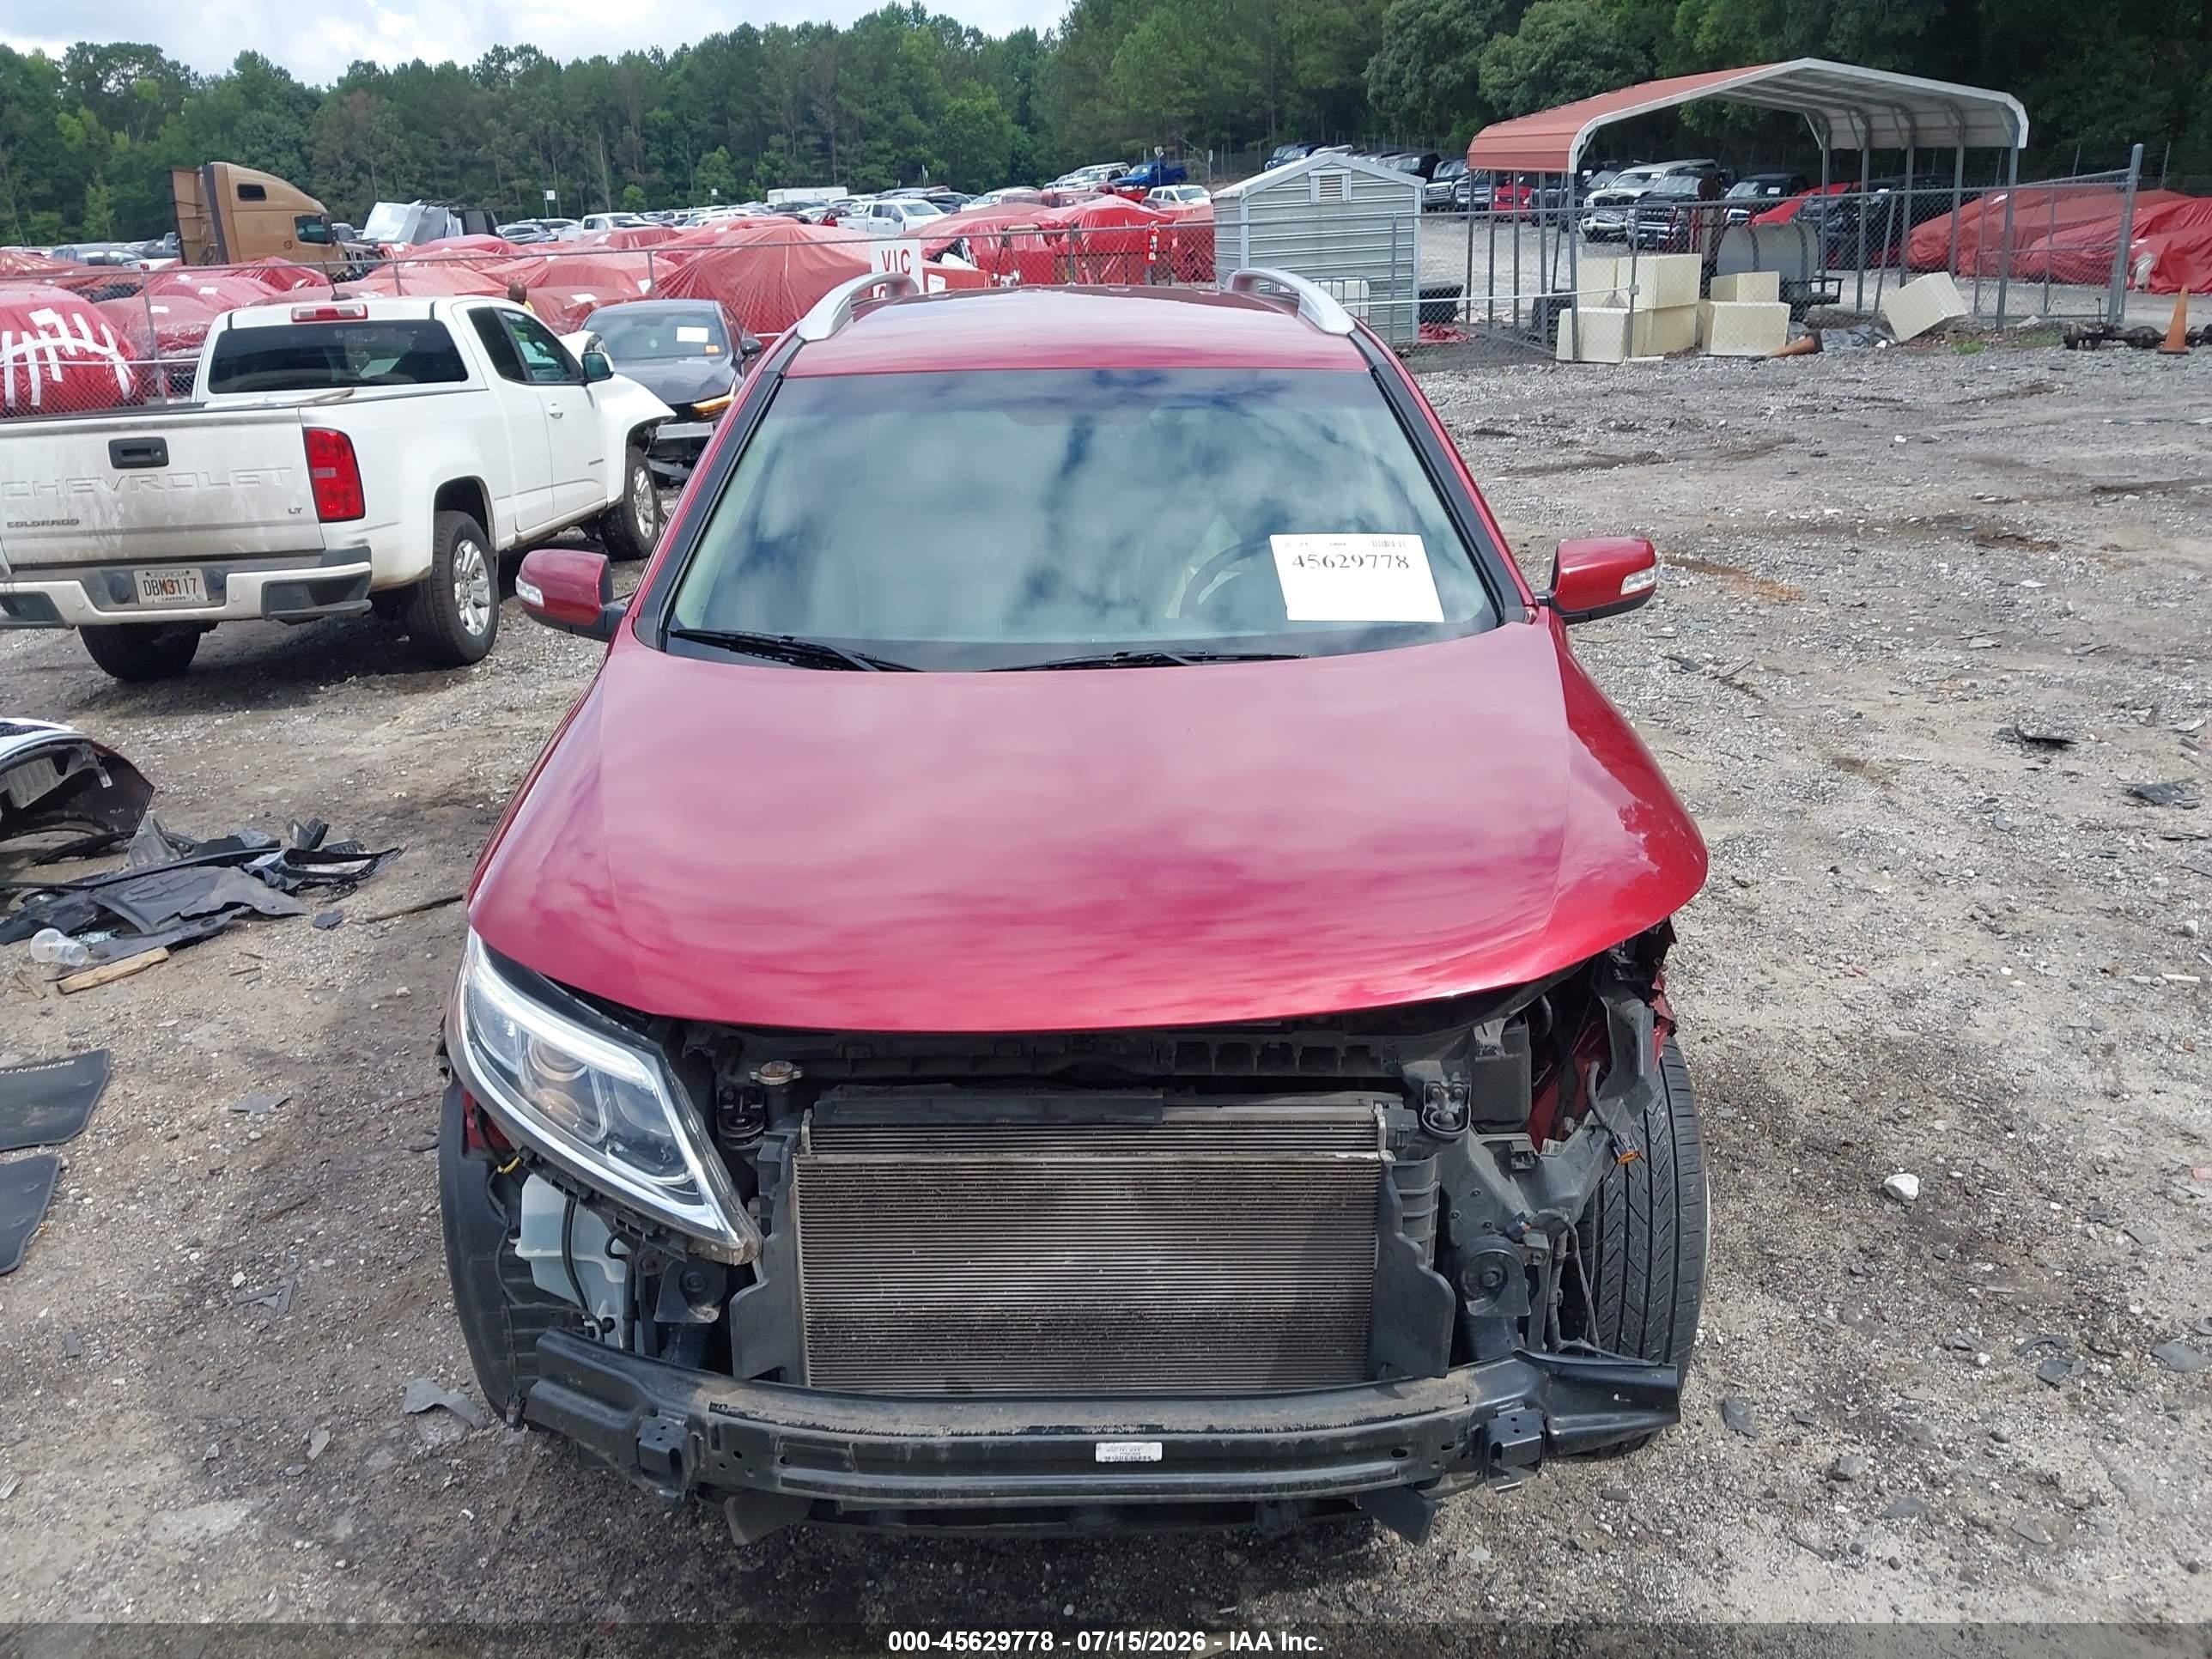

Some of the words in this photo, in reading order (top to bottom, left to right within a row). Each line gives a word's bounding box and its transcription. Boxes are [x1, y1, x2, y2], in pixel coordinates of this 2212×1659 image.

[880, 248, 911, 276] VIC
[1, 466, 293, 497] CHEVROLET
[6, 518, 80, 529] COLORADO
[1291, 553, 1410, 569] 45629778
